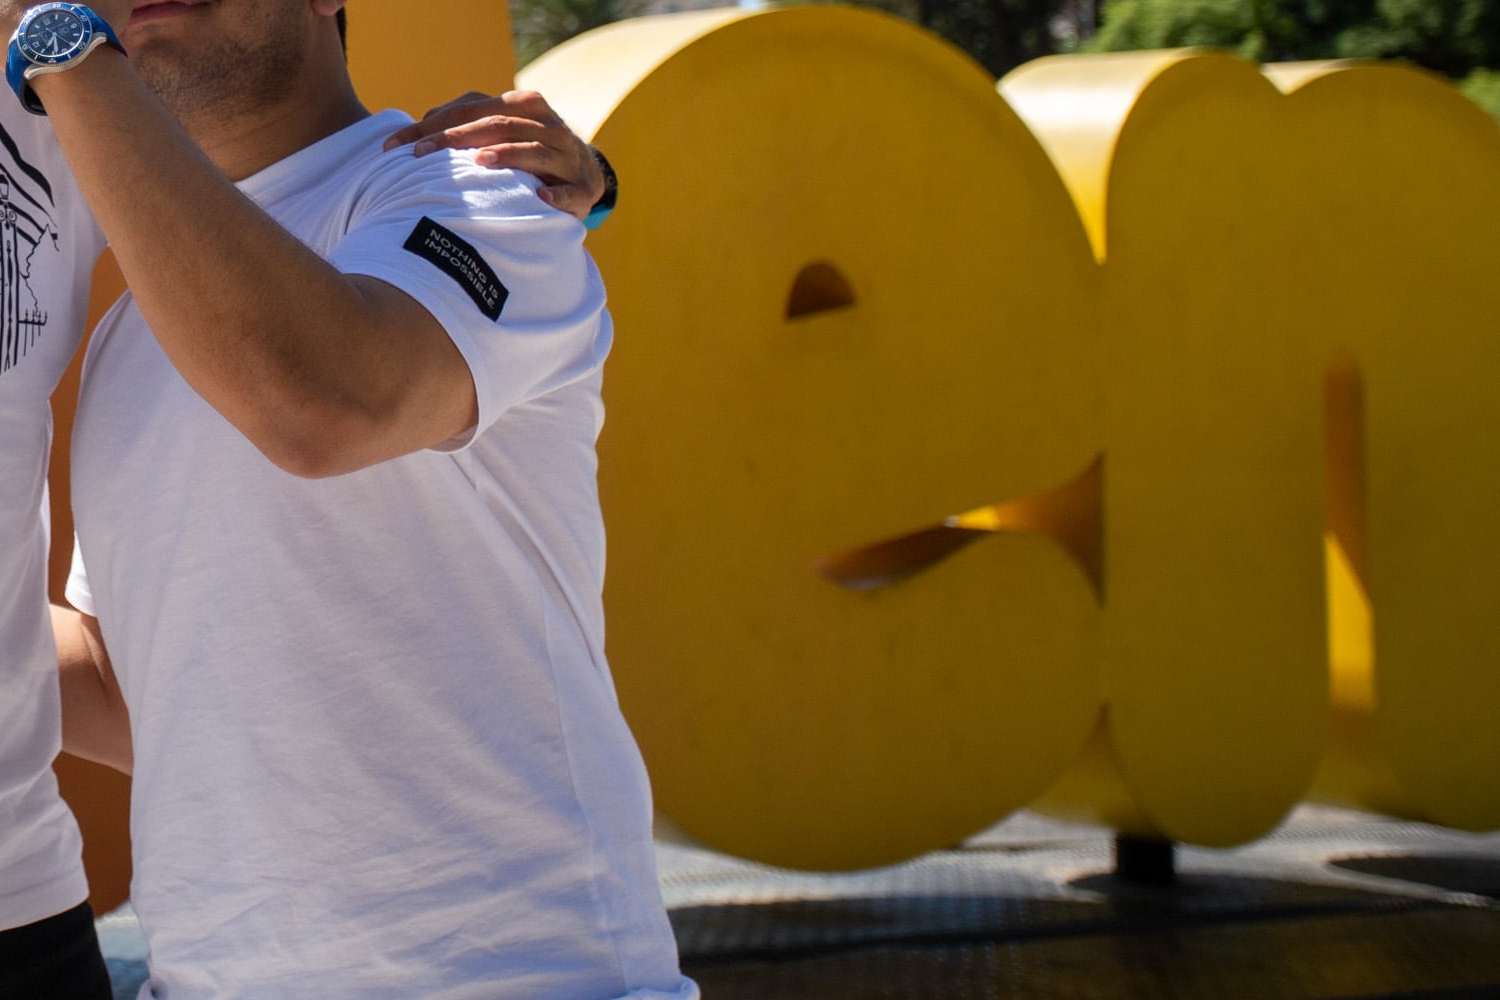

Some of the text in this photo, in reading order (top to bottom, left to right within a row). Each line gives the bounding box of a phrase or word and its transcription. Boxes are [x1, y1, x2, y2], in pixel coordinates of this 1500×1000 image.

[424, 237, 495, 310] IMPOSSIBLE
[429, 228, 499, 299] NOTHING IS
